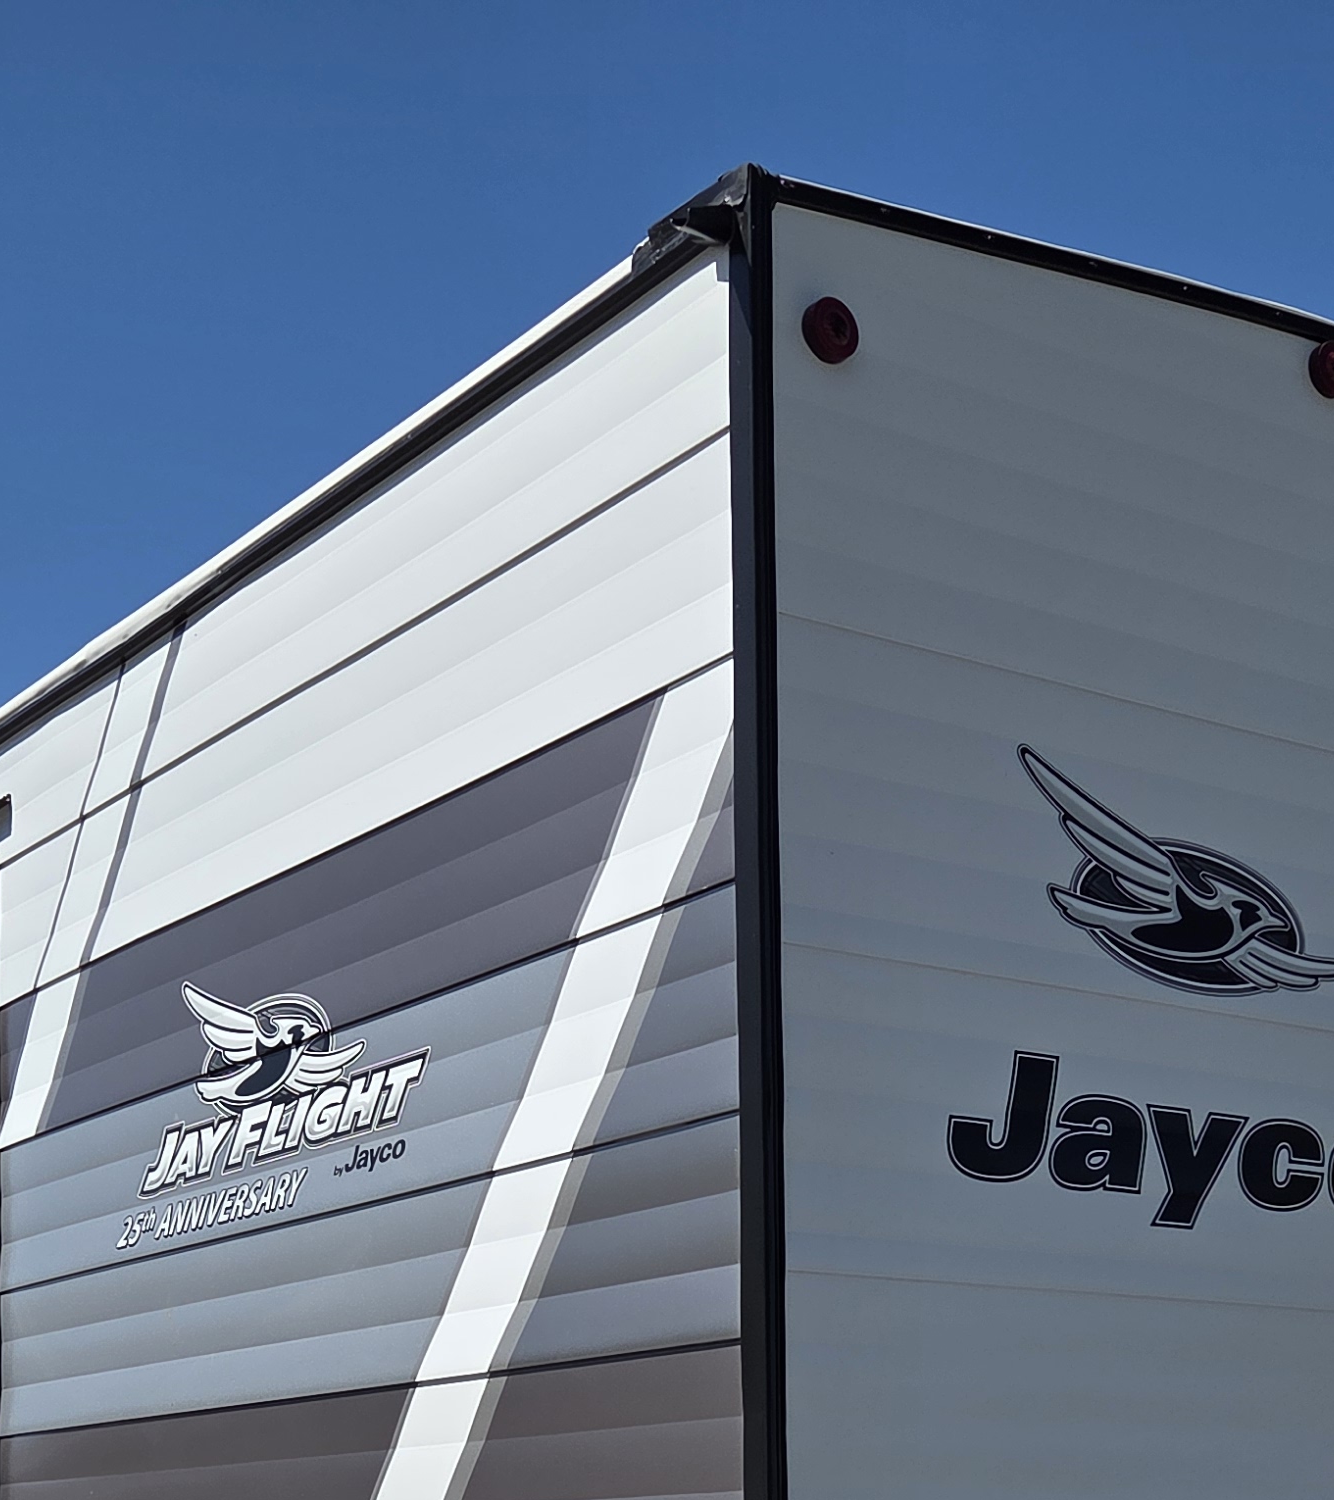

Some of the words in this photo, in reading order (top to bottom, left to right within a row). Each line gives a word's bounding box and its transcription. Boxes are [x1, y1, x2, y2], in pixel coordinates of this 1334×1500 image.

[138, 1113, 239, 1199] JAY
[222, 1046, 432, 1174] FLIGHT
[333, 1165, 344, 1177] by
[344, 1138, 406, 1173] Jayco
[115, 1205, 157, 1250] 25th
[154, 1166, 309, 1241] ANNIVERSARY
